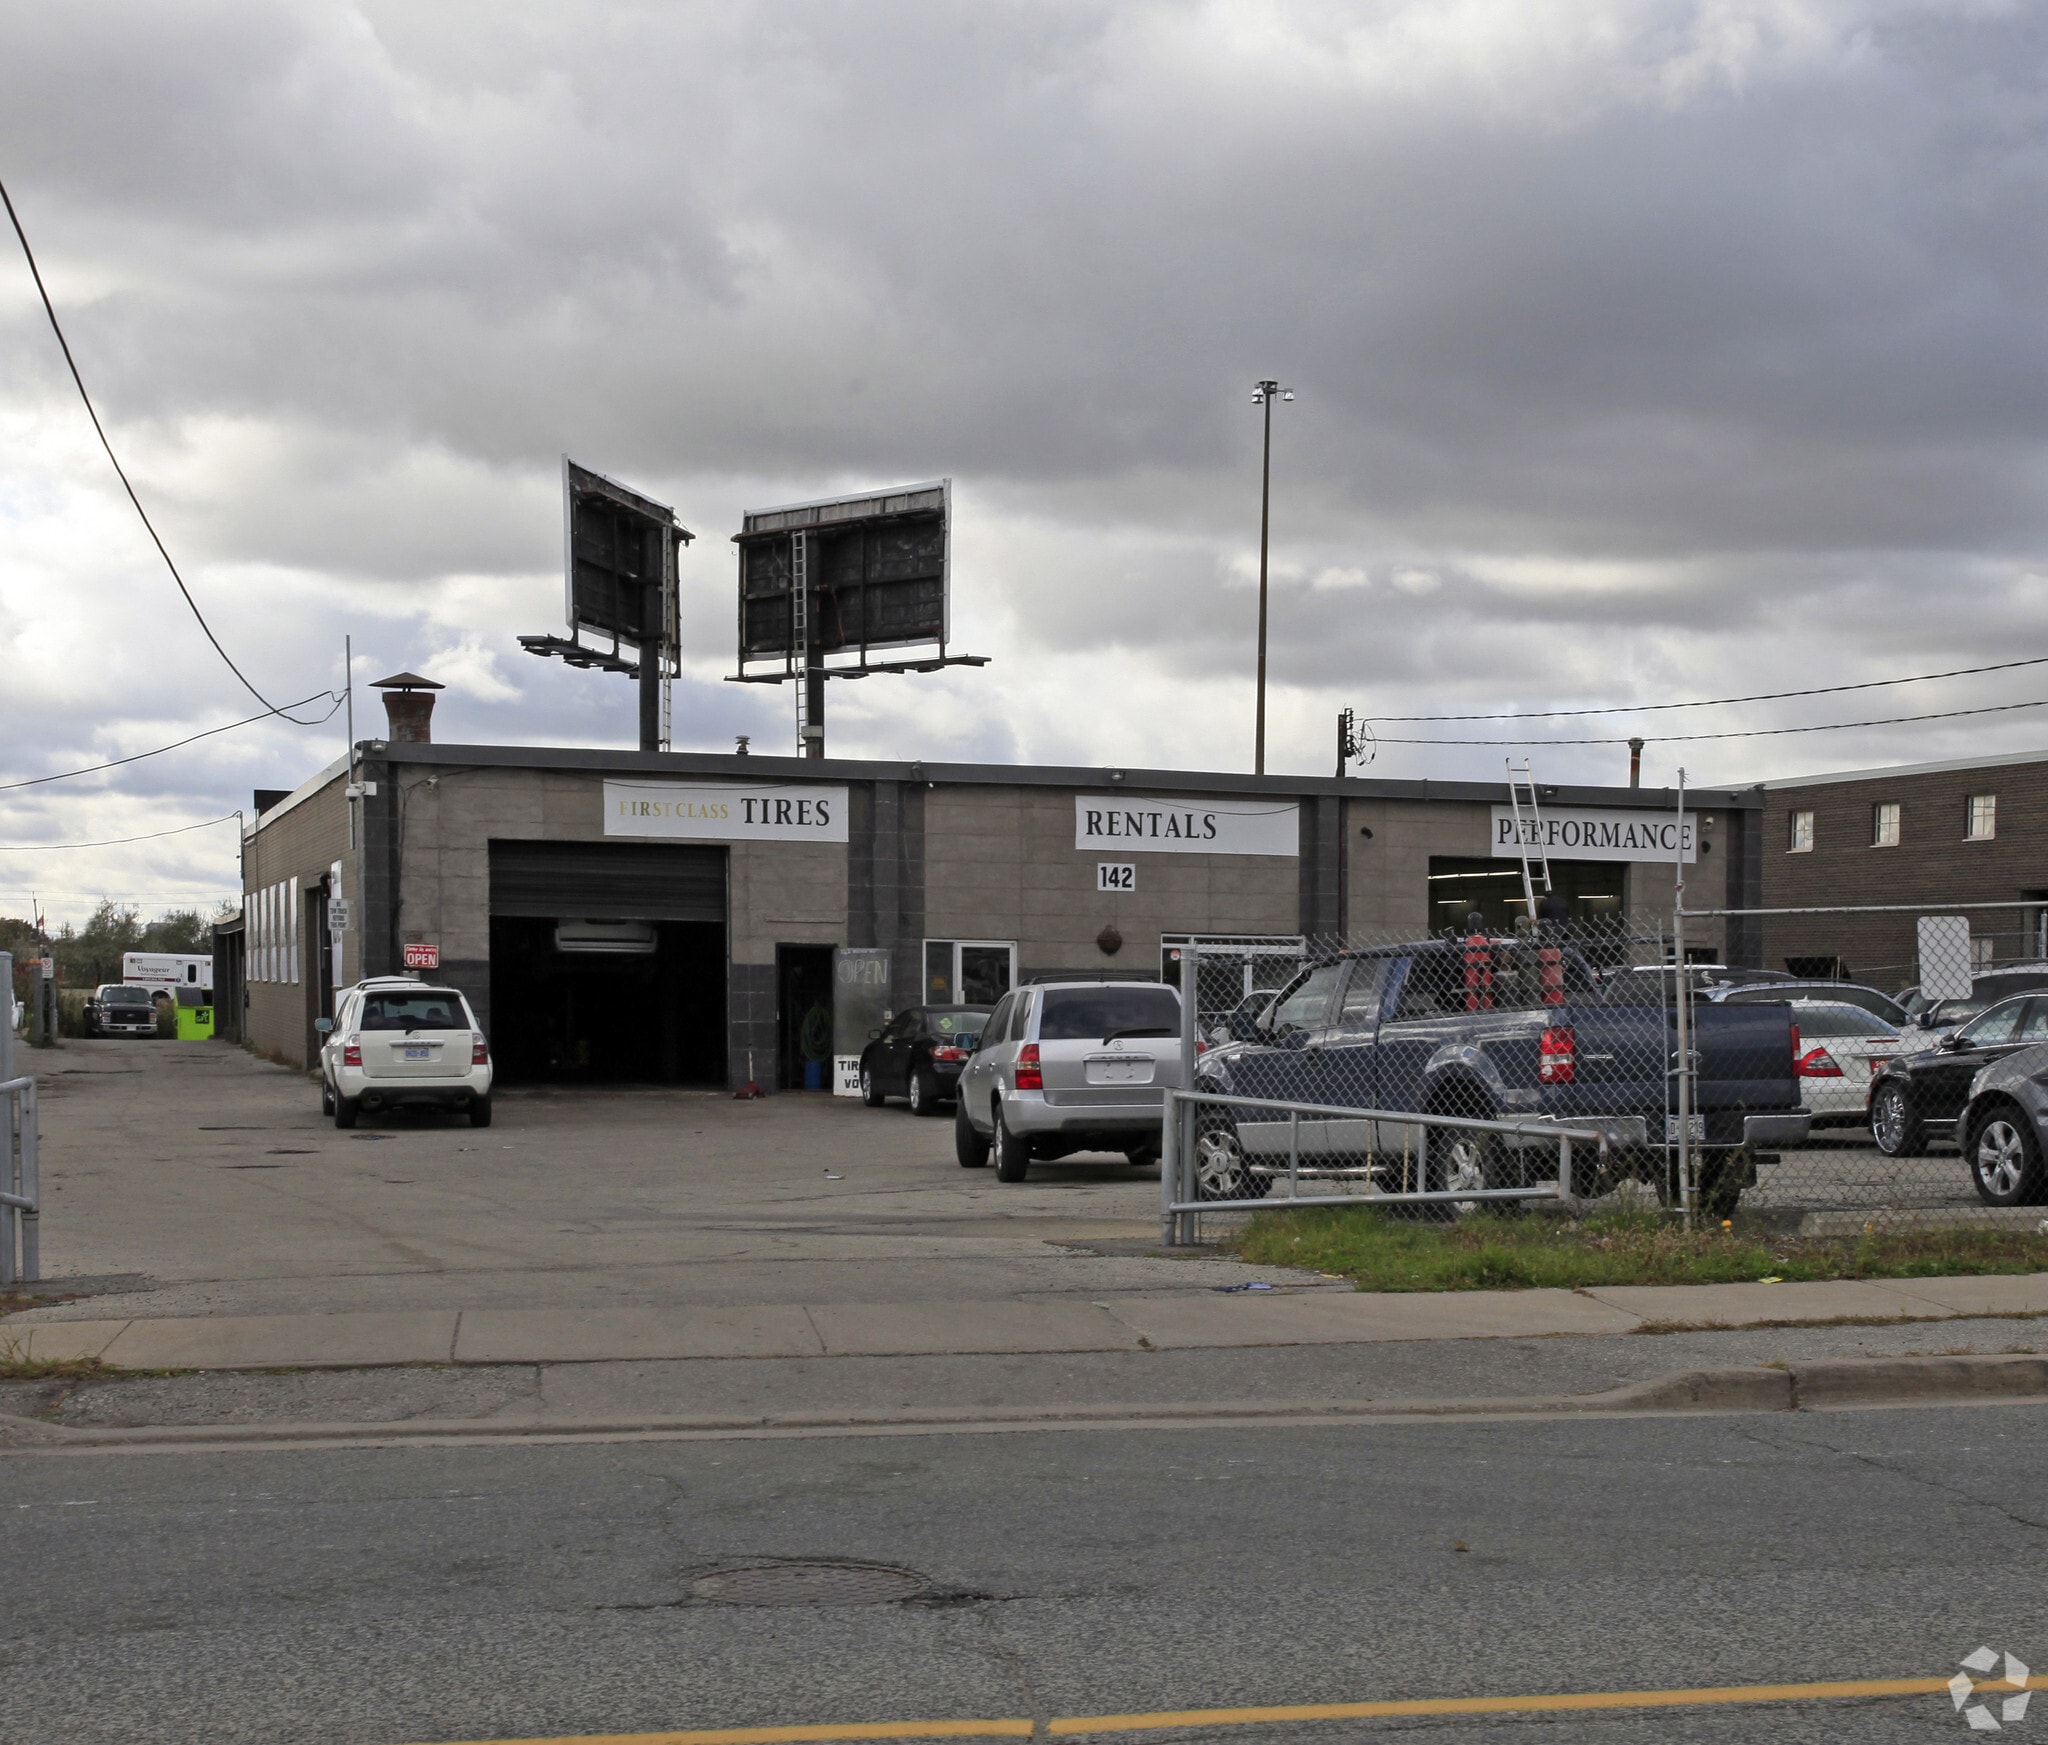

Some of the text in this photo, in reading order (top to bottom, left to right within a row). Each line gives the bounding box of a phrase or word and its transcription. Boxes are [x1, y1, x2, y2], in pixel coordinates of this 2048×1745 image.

[619, 798, 830, 826] FIRST CLASS TIRES
[1085, 810, 1217, 840] RENTALS
[1498, 818, 1692, 850] PERFORMANCE
[1100, 866, 1133, 889] 142
[407, 953, 436, 966] OPEN
[837, 959, 888, 984] OPEN
